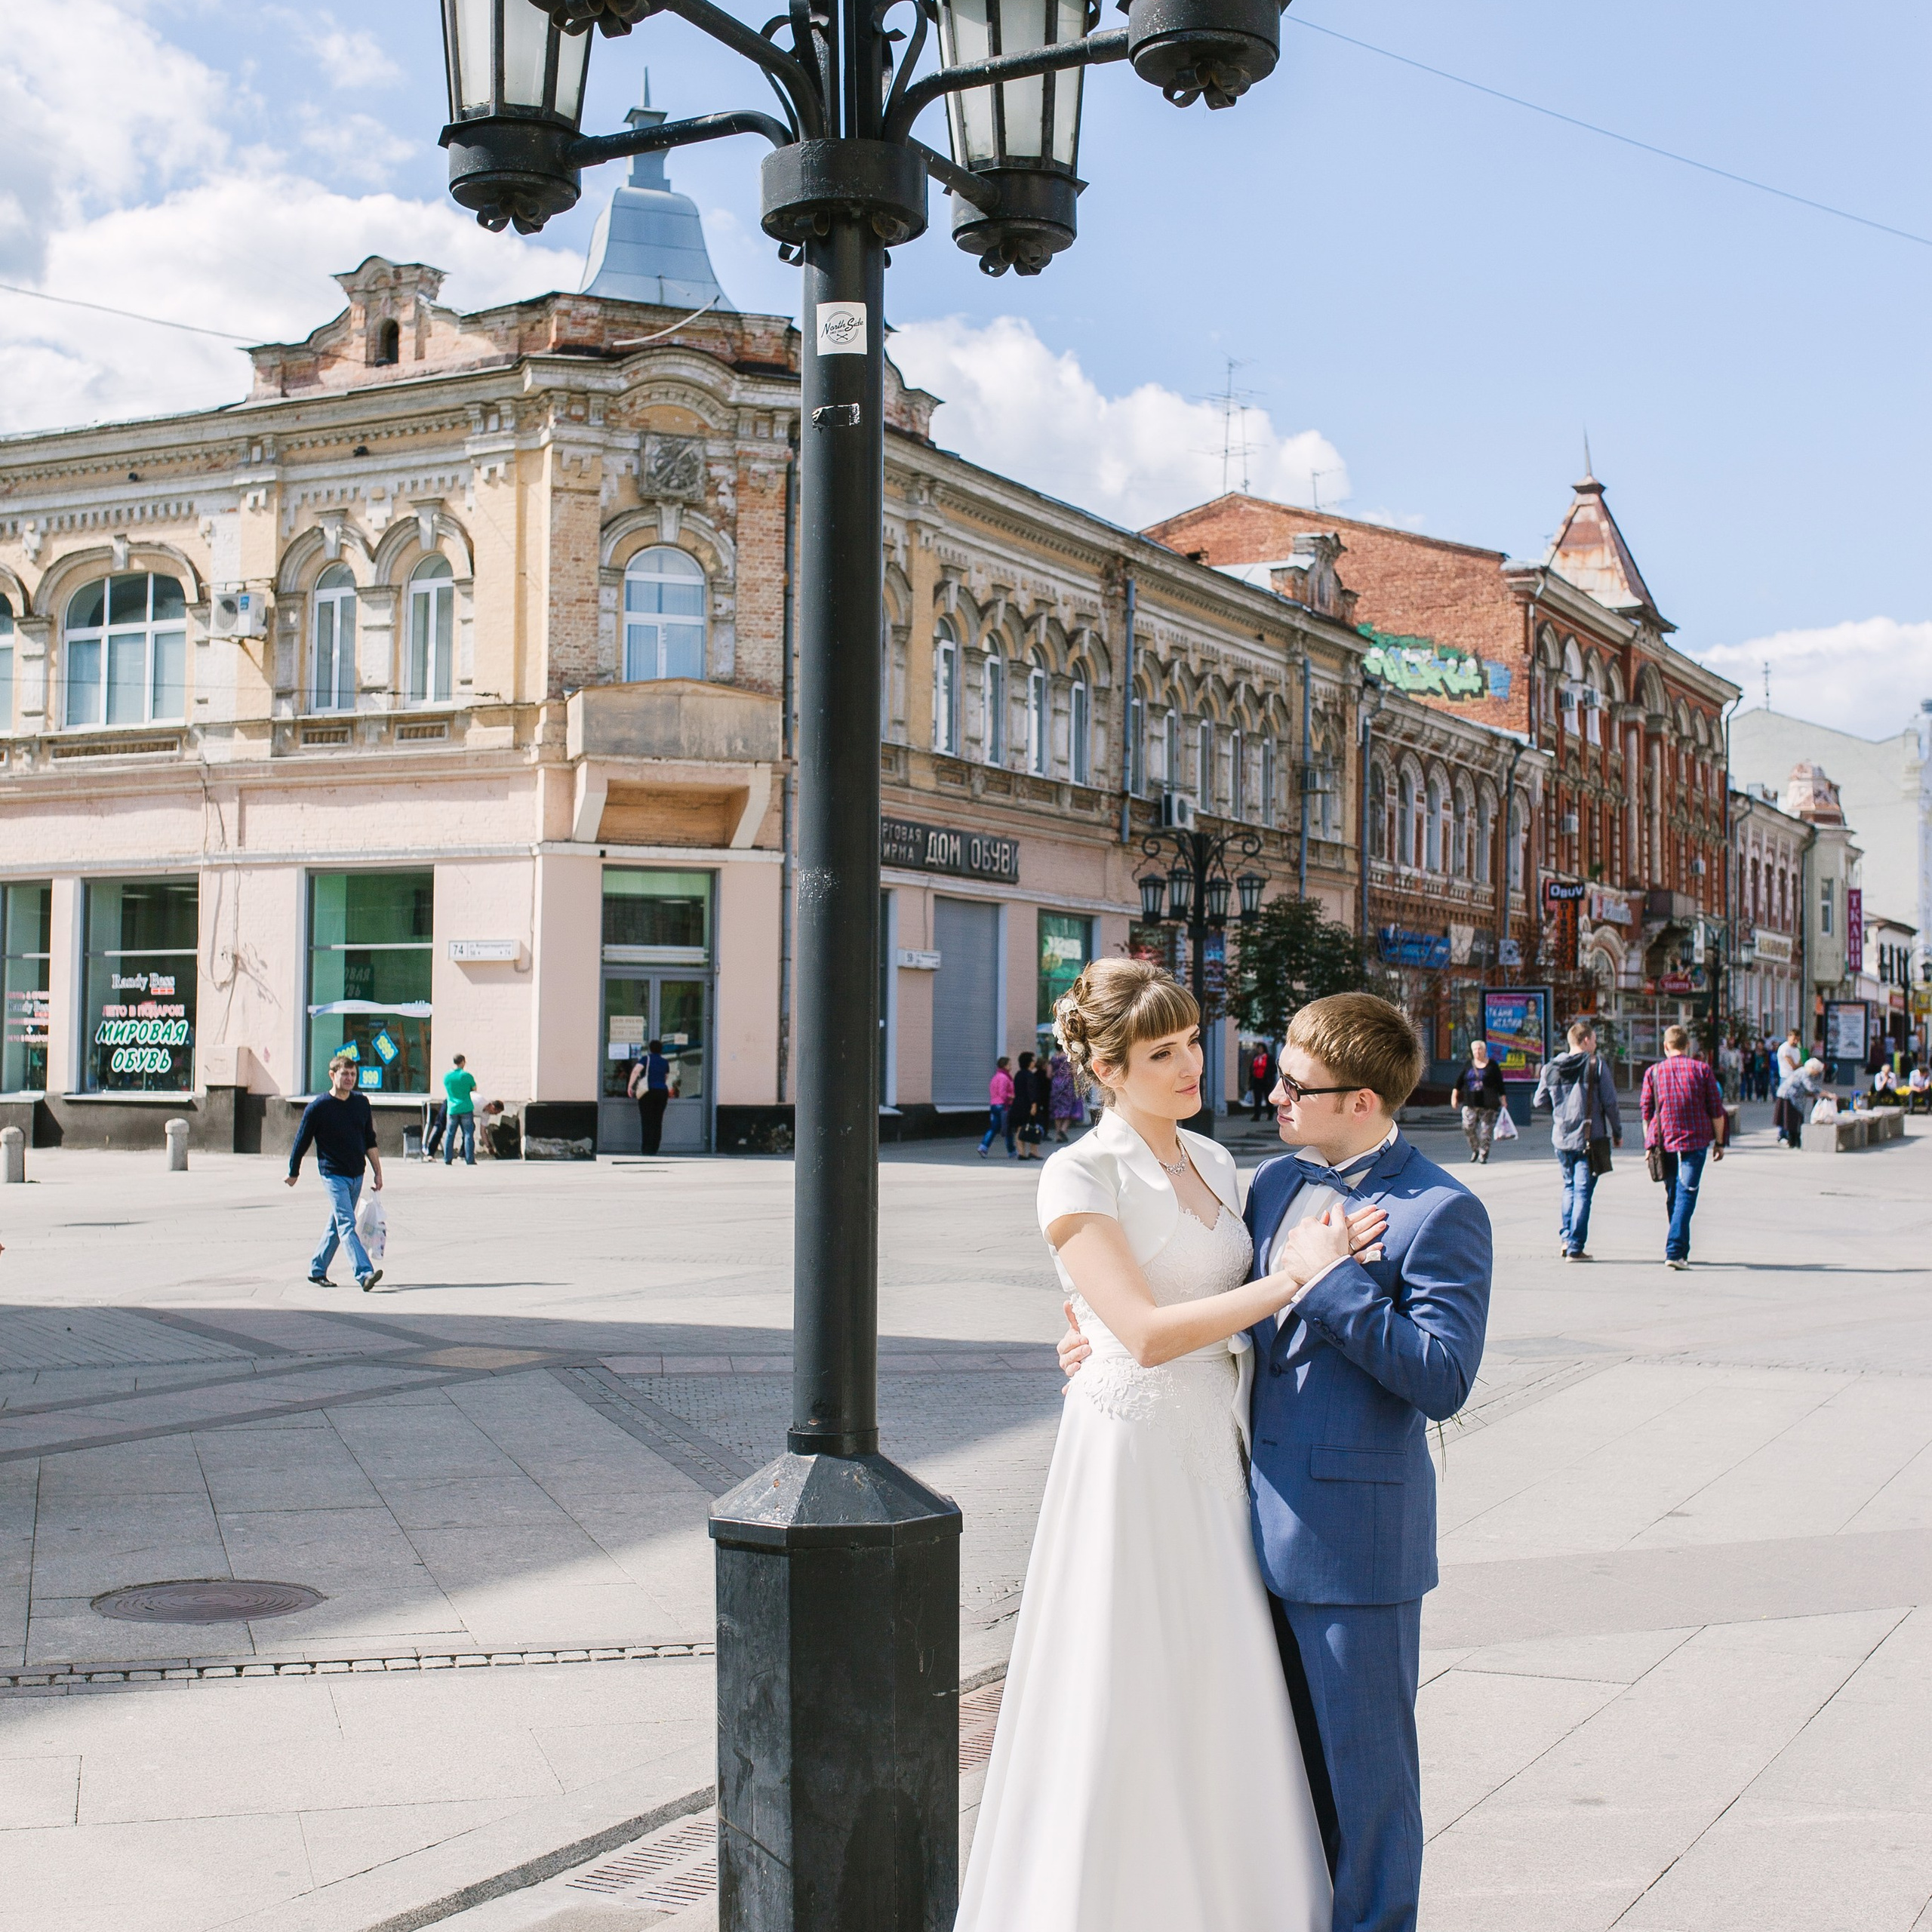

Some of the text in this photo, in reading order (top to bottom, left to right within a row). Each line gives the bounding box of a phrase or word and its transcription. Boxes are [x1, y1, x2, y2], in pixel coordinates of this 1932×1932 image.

[820, 317, 864, 338] North Side
[881, 822, 922, 844] РГОВАЯ
[881, 842, 915, 863] ИРМА
[924, 831, 961, 866] ДОМ
[1850, 894, 1860, 967] ТКАНИ
[454, 943, 464, 955] 74
[96, 1020, 188, 1044] МИРОВАЯ
[112, 1049, 171, 1072] ОБУВЬ
[362, 1070, 379, 1084] 999
